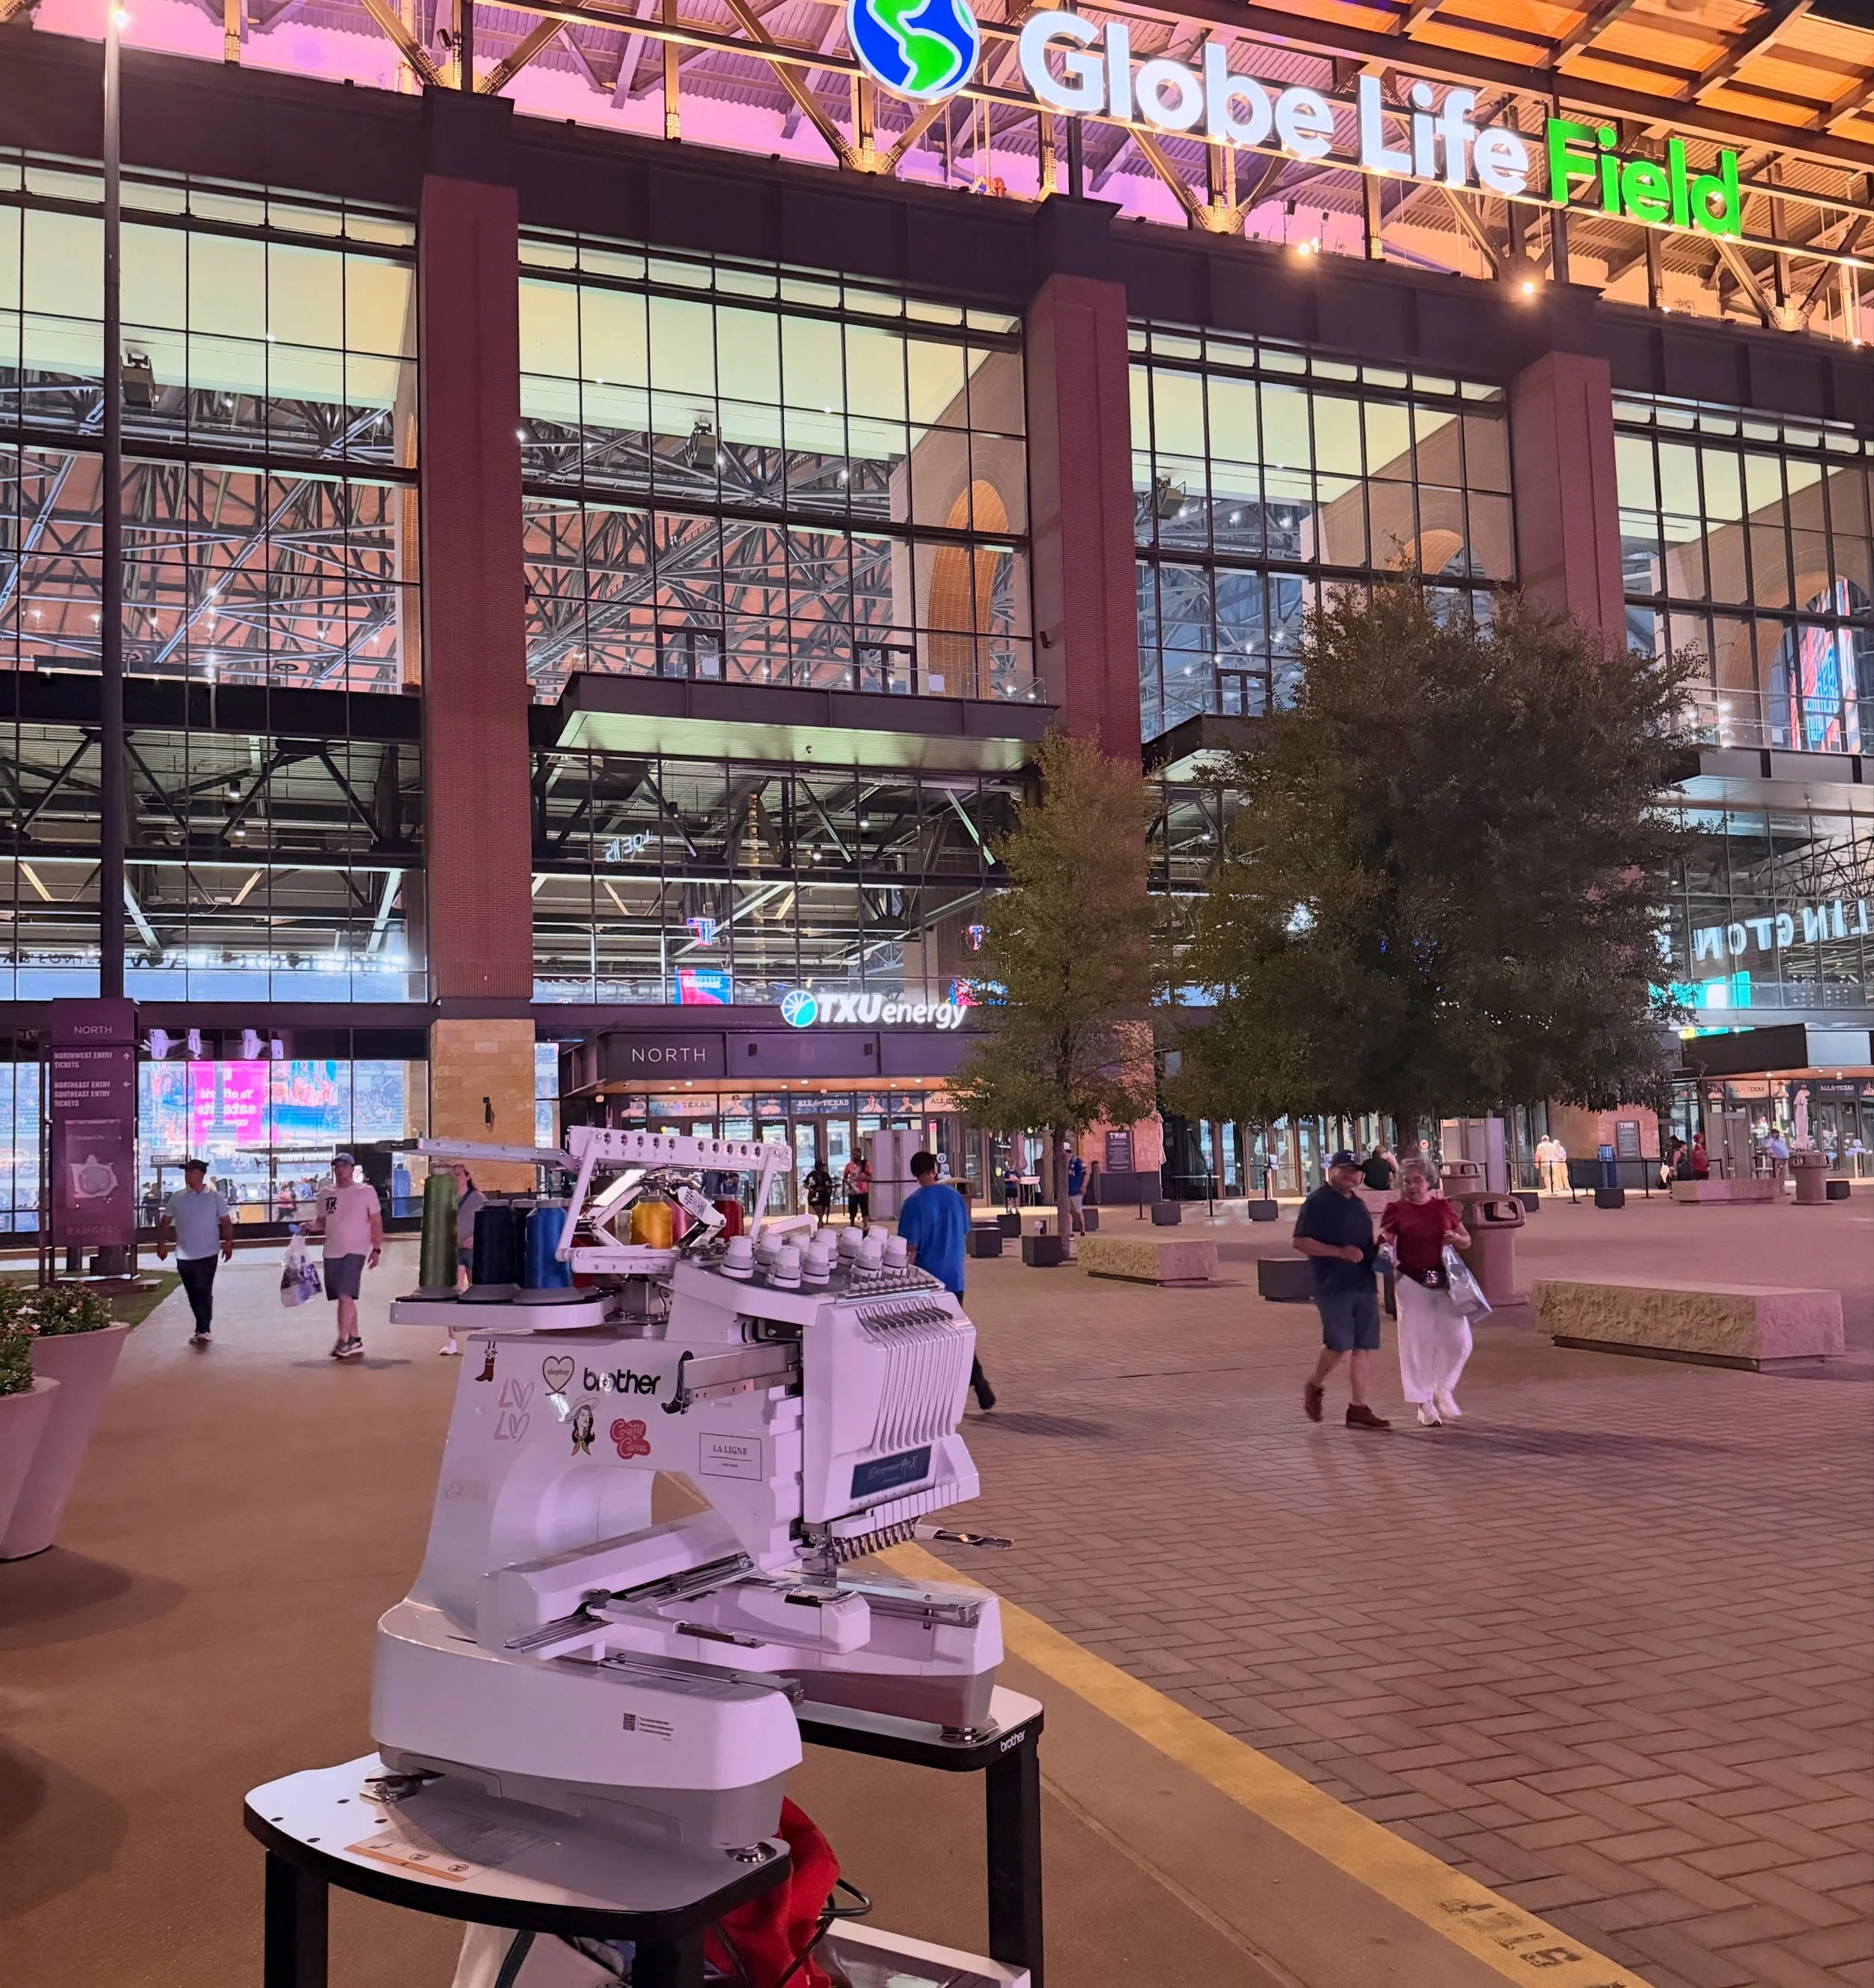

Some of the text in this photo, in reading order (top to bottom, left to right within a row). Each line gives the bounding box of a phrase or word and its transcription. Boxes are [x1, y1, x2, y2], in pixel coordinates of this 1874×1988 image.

[1018, 10, 1742, 238] Globe Life Field
[816, 993, 968, 1029] TXU energy
[74, 1025, 112, 1034] NORTH
[632, 1048, 705, 1062] NORTH
[583, 1367, 660, 1394] brother
[713, 1444, 748, 1455] LA LIGNE
[1000, 1729, 1026, 1753] brother
